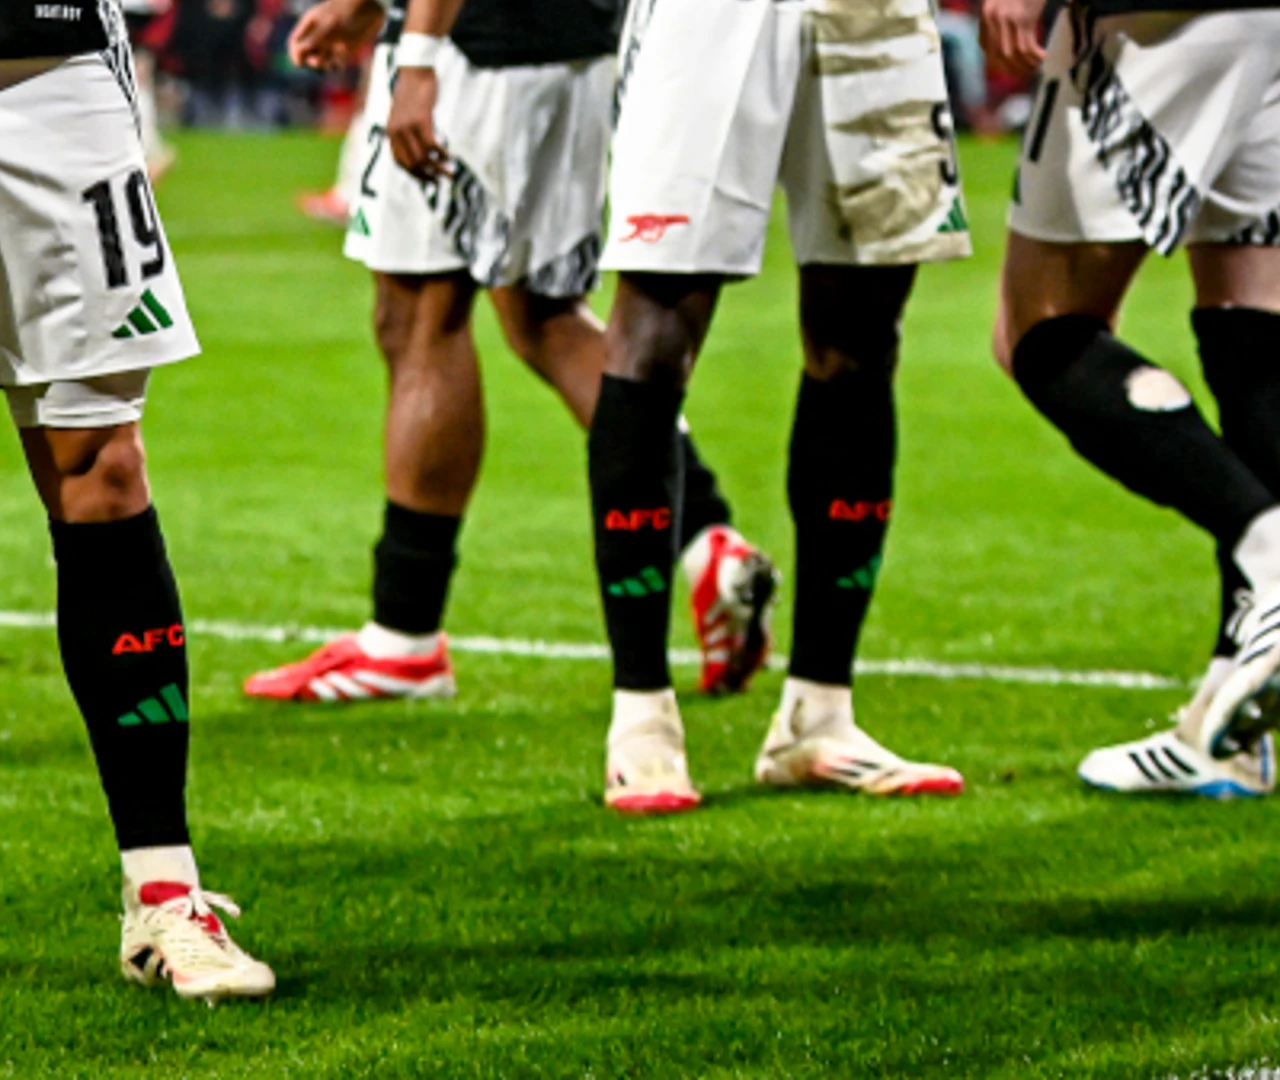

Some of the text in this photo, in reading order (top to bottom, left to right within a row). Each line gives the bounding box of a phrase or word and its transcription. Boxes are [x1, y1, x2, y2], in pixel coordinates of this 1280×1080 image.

[81, 170, 166, 289] 19
[605, 508, 671, 530] AFC
[111, 623, 185, 655] AFC
